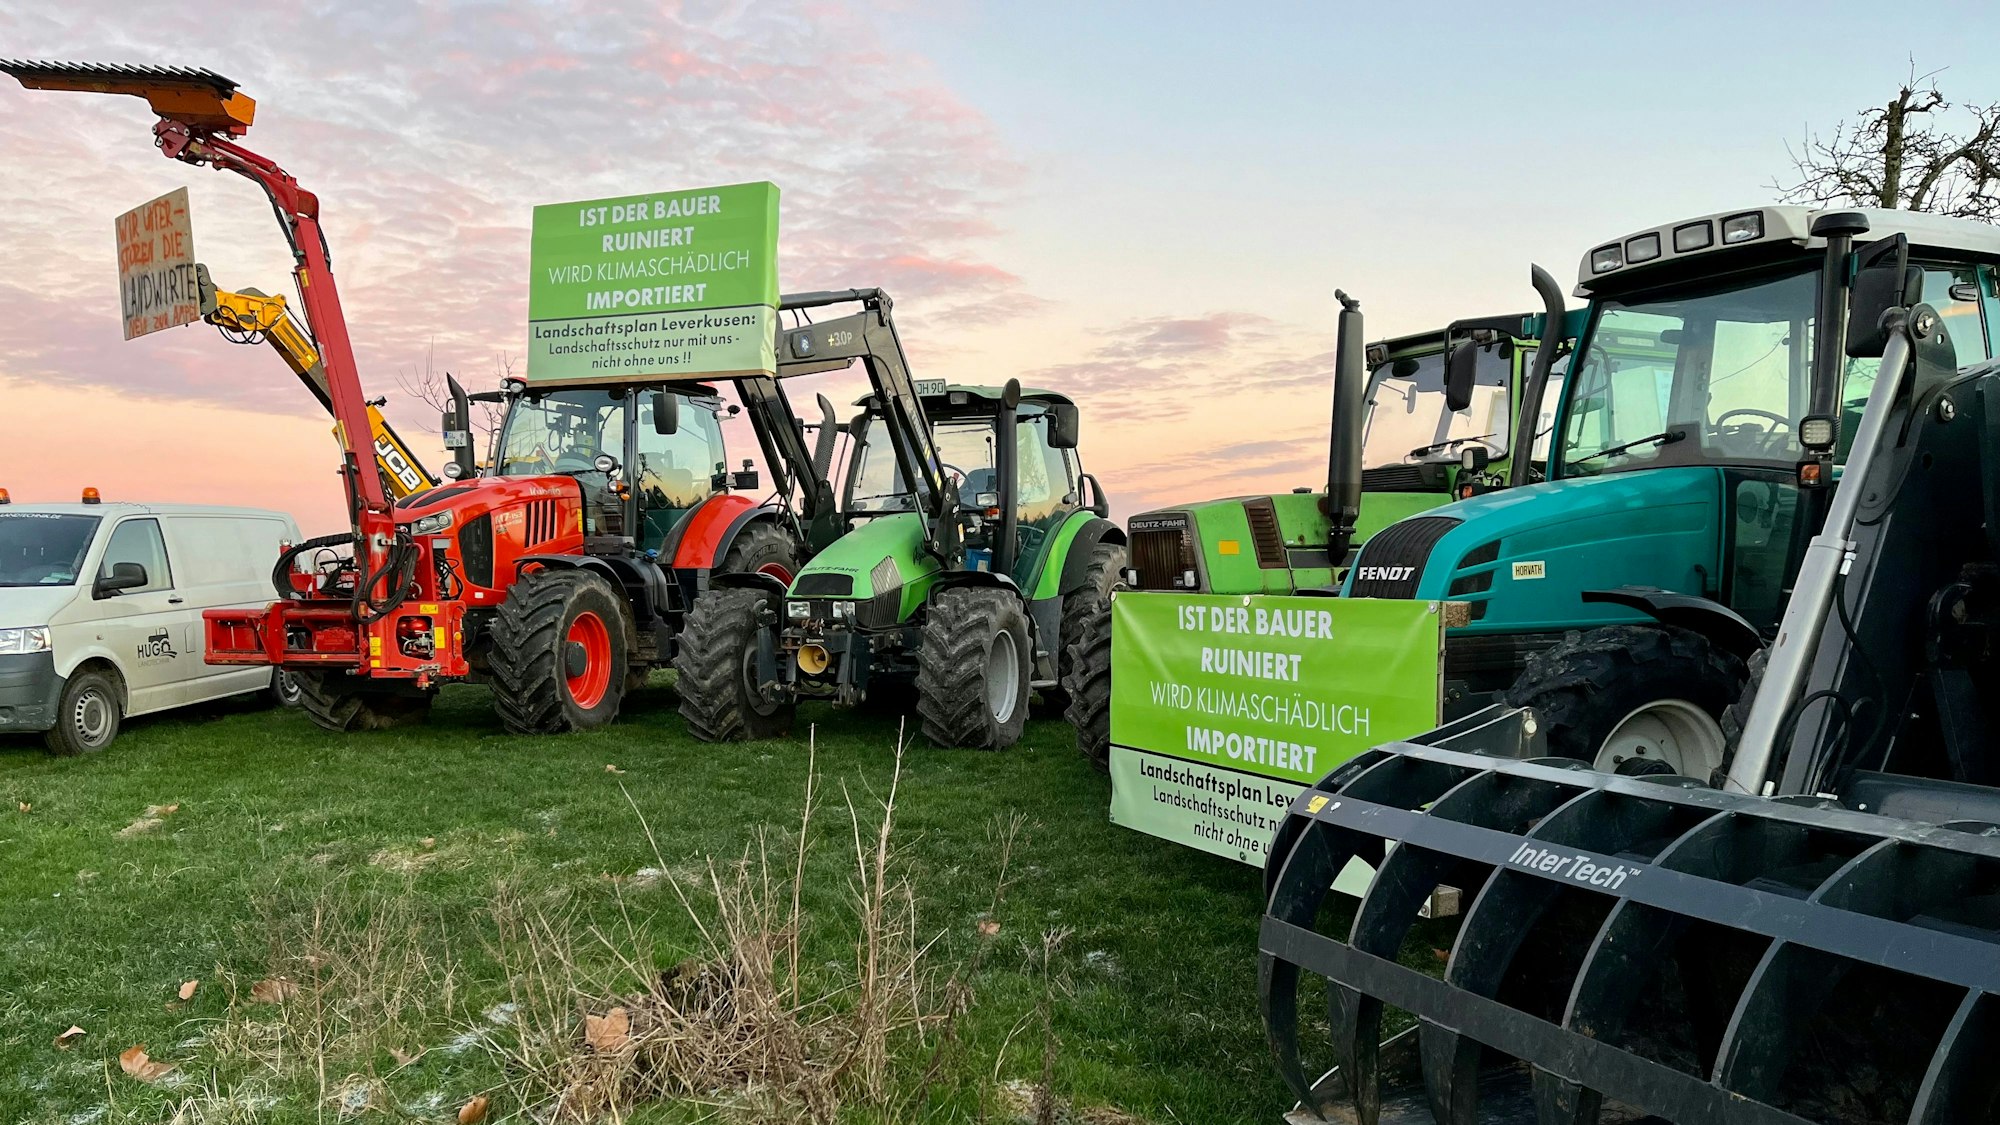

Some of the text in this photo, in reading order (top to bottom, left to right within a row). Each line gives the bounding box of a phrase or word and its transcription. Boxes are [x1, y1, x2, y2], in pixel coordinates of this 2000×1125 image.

[118, 211, 140, 243] WIR
[579, 195, 721, 227] IST DER BAUER
[163, 232, 185, 260] DIE
[602, 226, 695, 253] RUINIERT
[548, 249, 750, 285] WIRD KLIMASCHÄDLICH
[123, 264, 197, 321] LANDWIRTE
[586, 283, 708, 310] IMPORTIERT
[535, 314, 756, 339] Landschaftsplan Leverkusen:
[548, 337, 660, 355] Landschaftsschutz
[664, 337, 684, 348] nur
[687, 334, 707, 347] mit
[710, 335, 732, 345] uns
[592, 352, 692, 369] nicht ohne uns !!
[374, 440, 421, 491] JCB
[1358, 567, 1415, 581] FENDT
[1515, 564, 1543, 577] HORVATH
[1178, 605, 1334, 640] IST DER BAUER
[1201, 647, 1302, 682] RUINIERT
[1150, 681, 1370, 737] WIRD KLIMASCHÄDLICH
[1187, 725, 1317, 774] IMPORTIERT
[1140, 758, 1262, 802] Landschaftsplan
[1153, 786, 1265, 829] Landschaftsschutz
[1194, 820, 1224, 842] nicht
[1226, 829, 1259, 852] ohne
